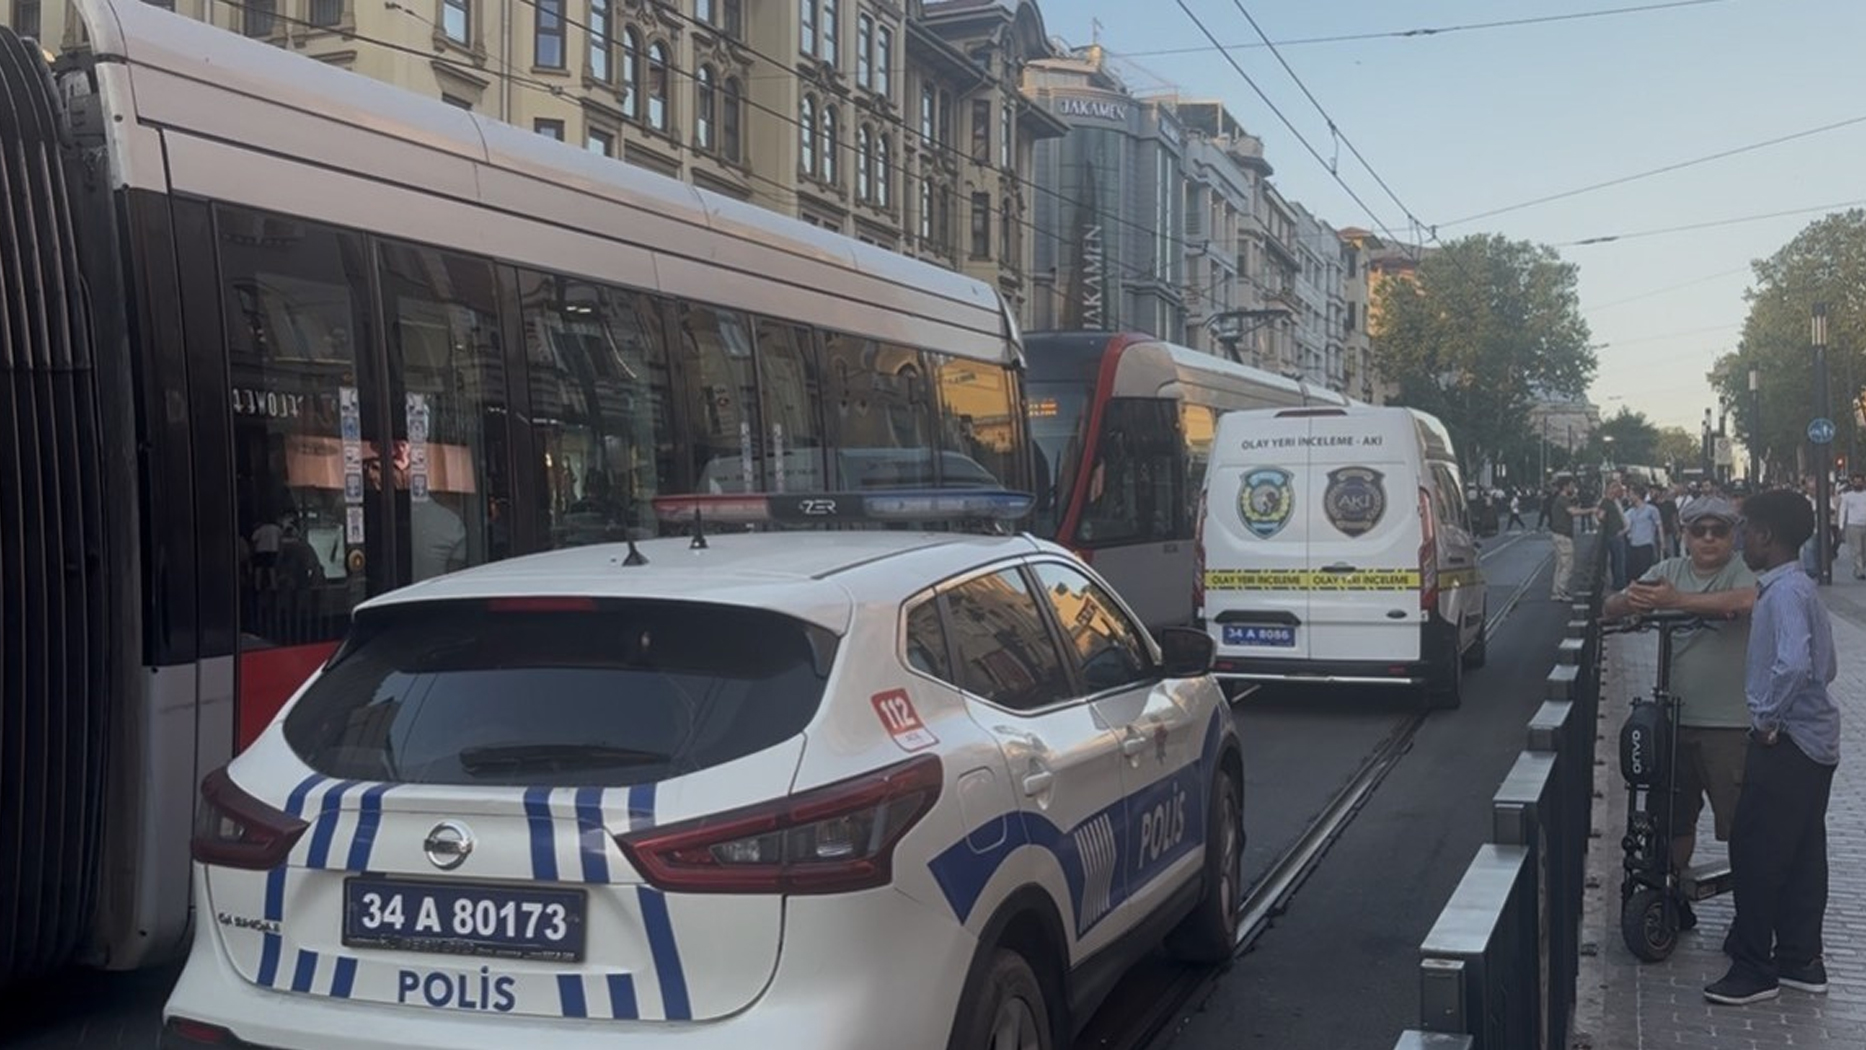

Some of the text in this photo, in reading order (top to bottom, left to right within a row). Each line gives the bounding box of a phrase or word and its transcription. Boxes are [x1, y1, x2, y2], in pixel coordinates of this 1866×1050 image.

[1061, 99, 1128, 120] JAKAMEN
[1241, 438, 1270, 450] OLAY
[1246, 628, 1257, 640] A
[880, 696, 917, 730] 112
[362, 892, 568, 941] 34 A 80173
[398, 964, 517, 1013] POLİS
